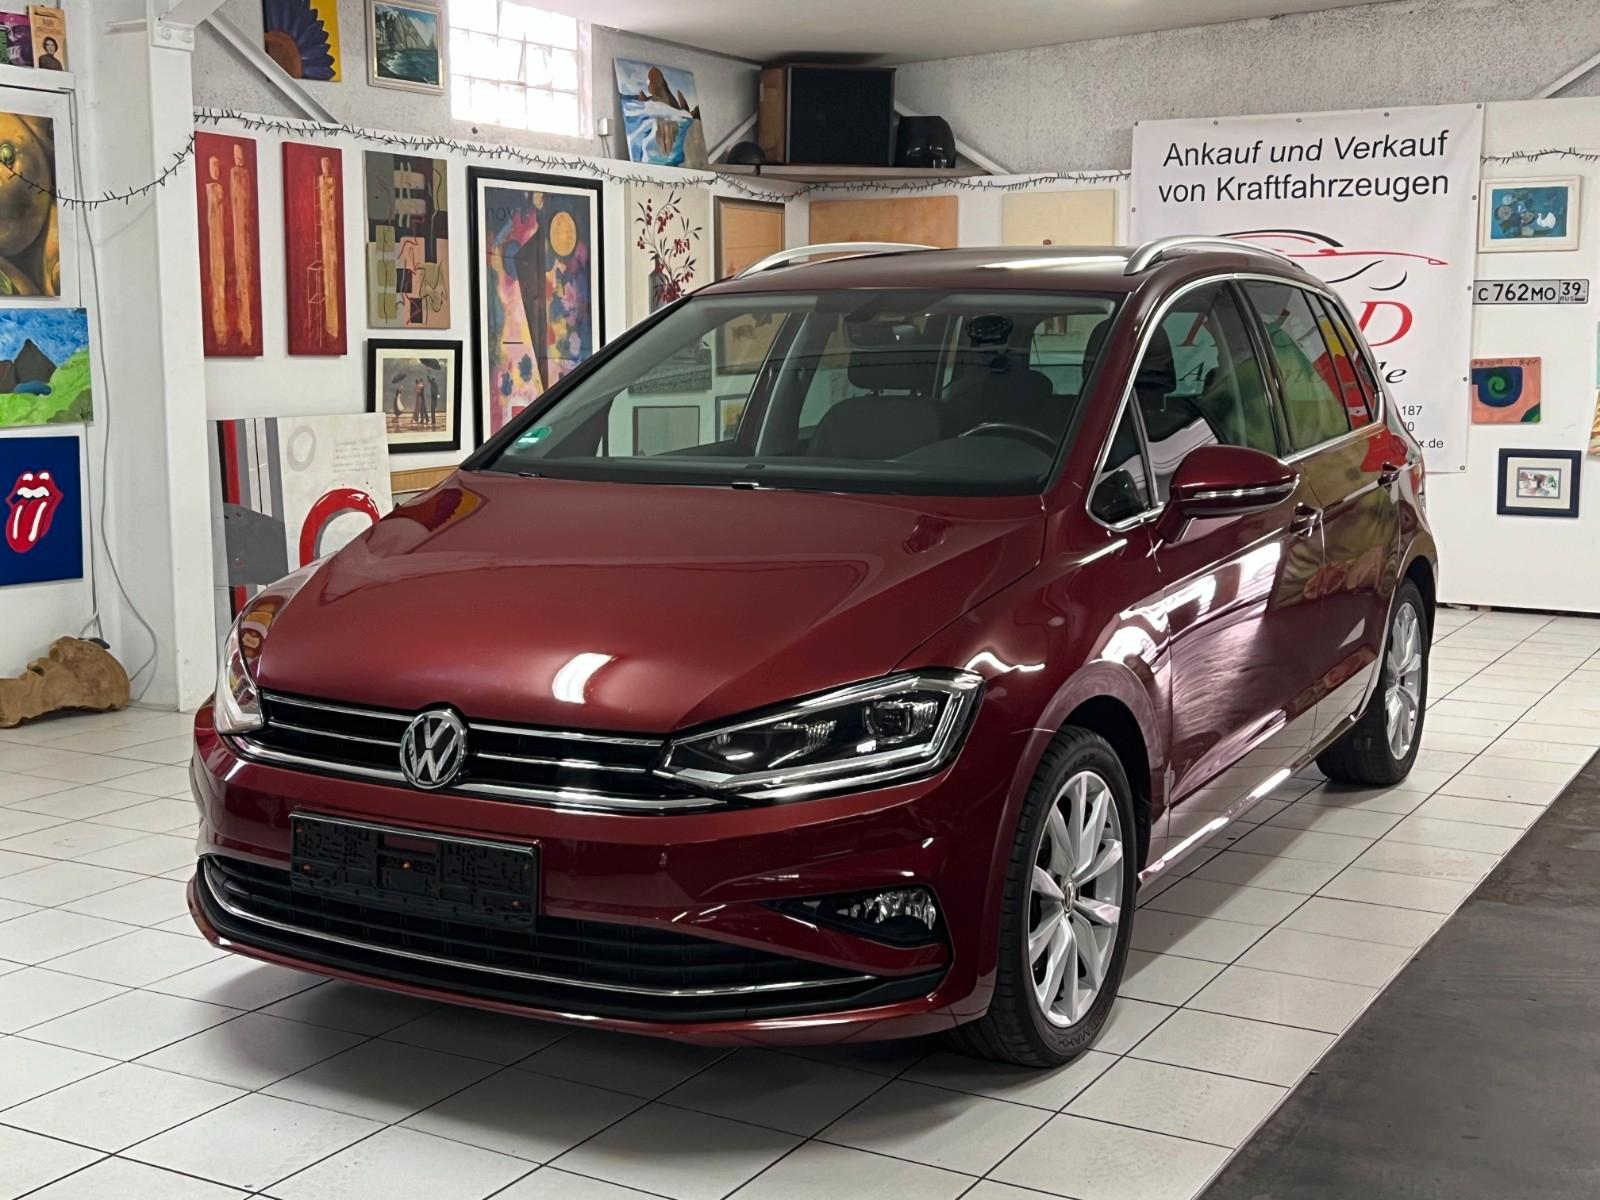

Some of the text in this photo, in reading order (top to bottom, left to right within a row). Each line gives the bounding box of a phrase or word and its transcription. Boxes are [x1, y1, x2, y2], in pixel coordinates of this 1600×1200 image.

[1163, 129, 1449, 167] Ankauf und Verkauf
[1158, 173, 1449, 203] von Kraftfahrzeugen
[1401, 405, 1423, 416] 187
